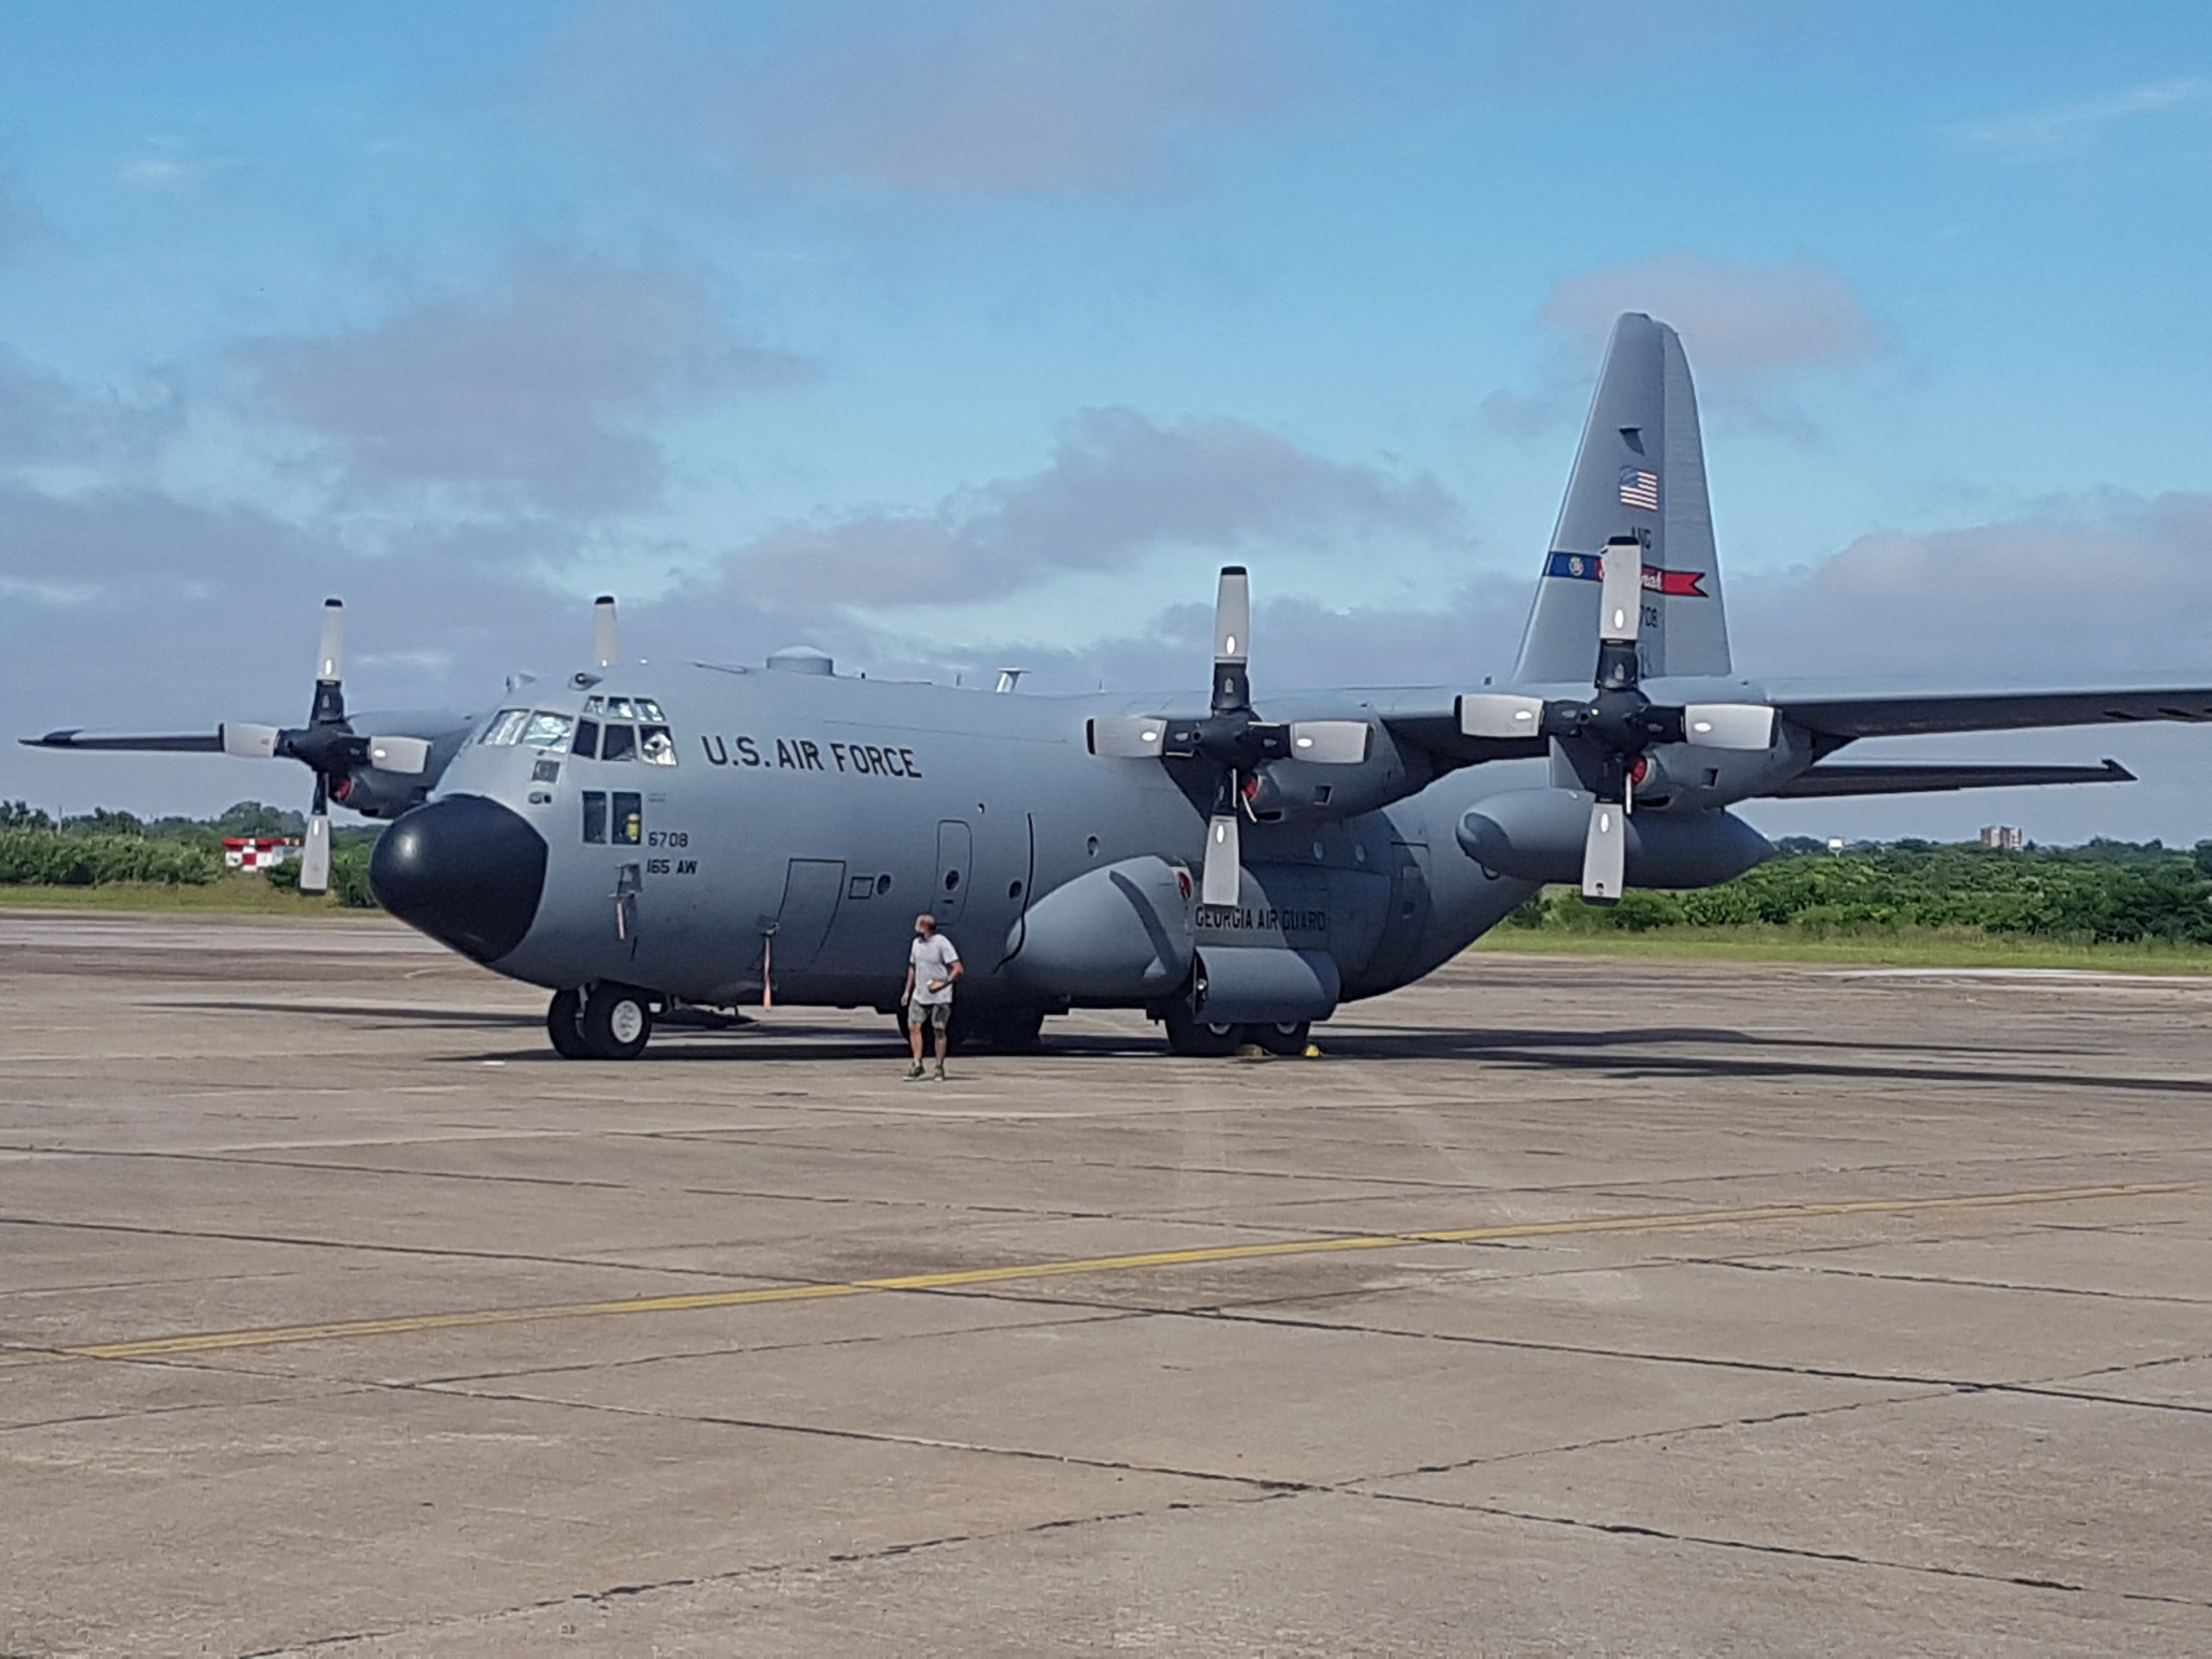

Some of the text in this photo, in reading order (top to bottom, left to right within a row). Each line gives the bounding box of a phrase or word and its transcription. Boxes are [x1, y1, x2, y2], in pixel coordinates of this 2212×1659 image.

[701, 734, 923, 778] U.S. AIR FORCE
[648, 831, 689, 848] 6708
[646, 859, 697, 875] 165 AW
[1195, 906, 1325, 931] GEORGIA AIR GUARD
